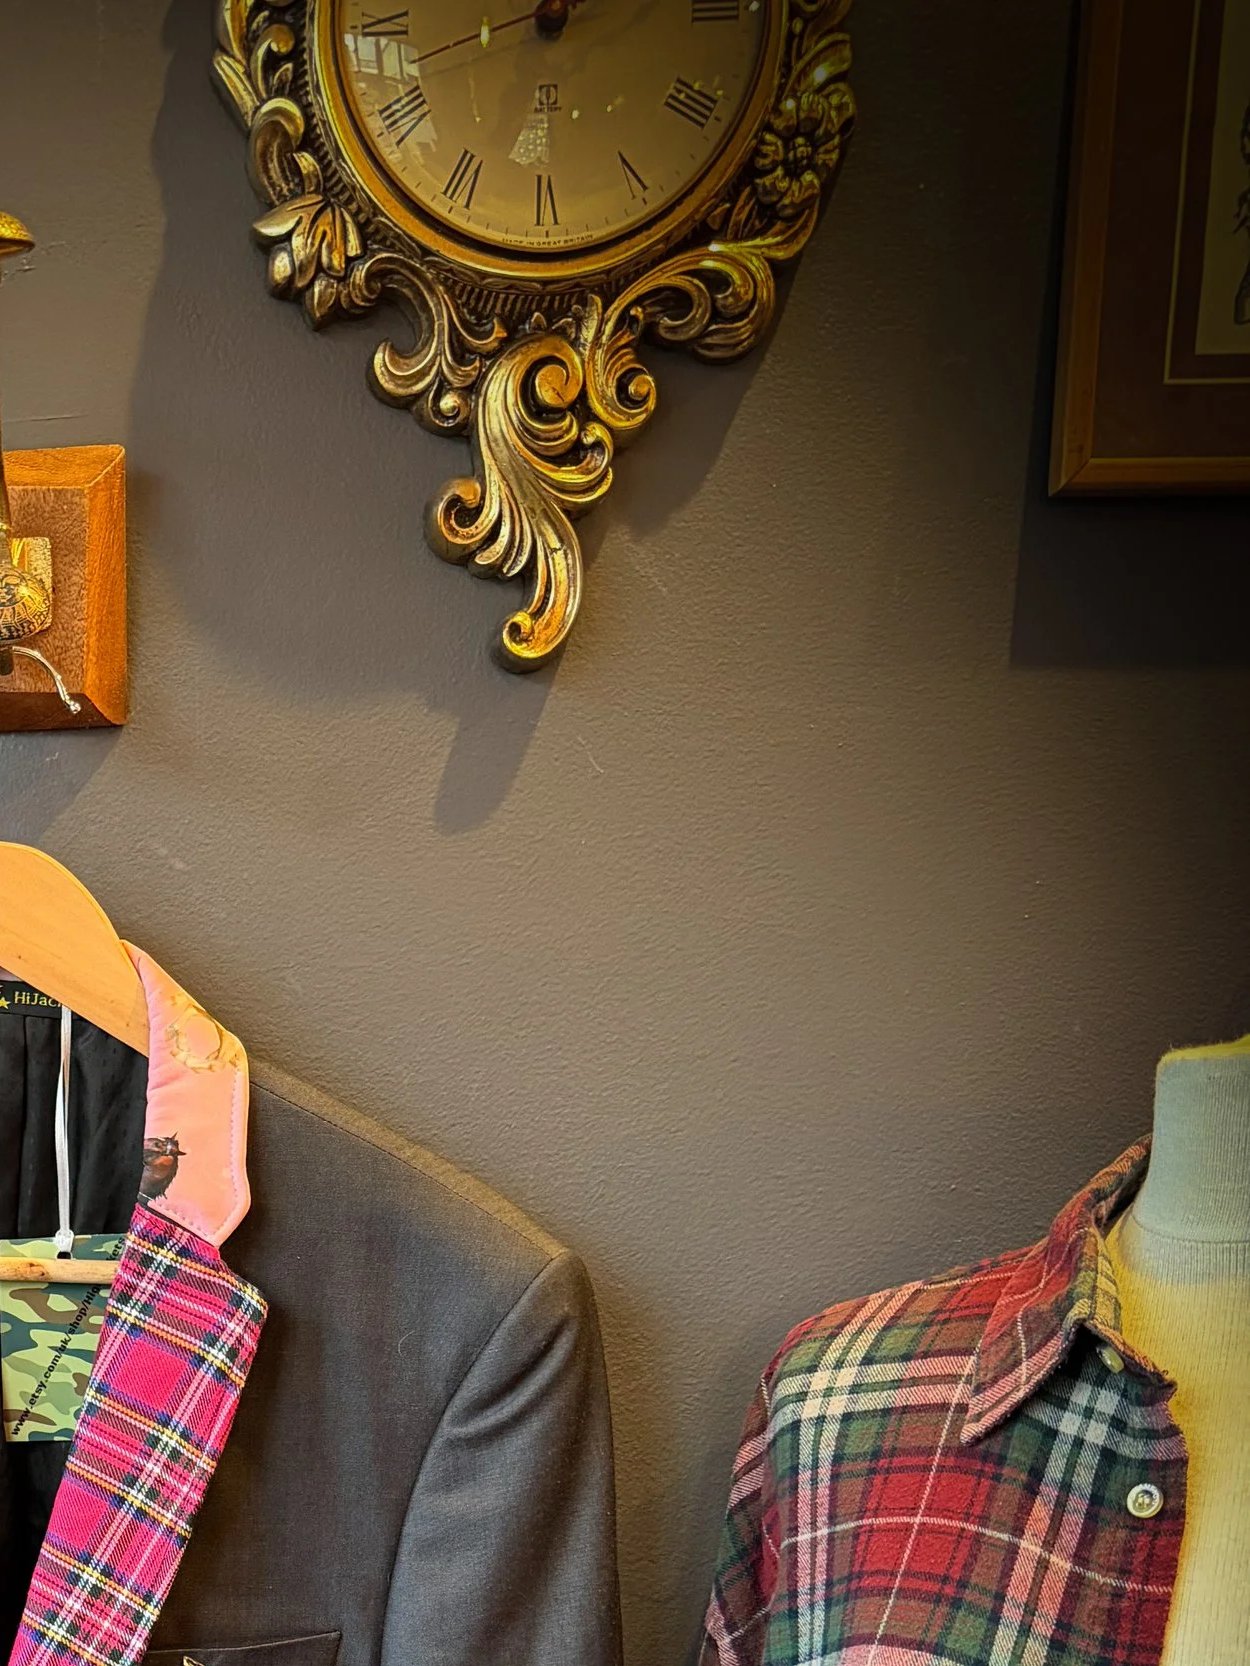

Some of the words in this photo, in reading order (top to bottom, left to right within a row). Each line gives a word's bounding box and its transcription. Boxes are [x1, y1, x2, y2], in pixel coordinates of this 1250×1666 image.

[361, 9, 409, 38] IX
[377, 84, 431, 148] VIII
[663, 76, 718, 130] IIII
[439, 148, 484, 210] VII
[534, 174, 559, 227] VI
[617, 150, 649, 200] V
